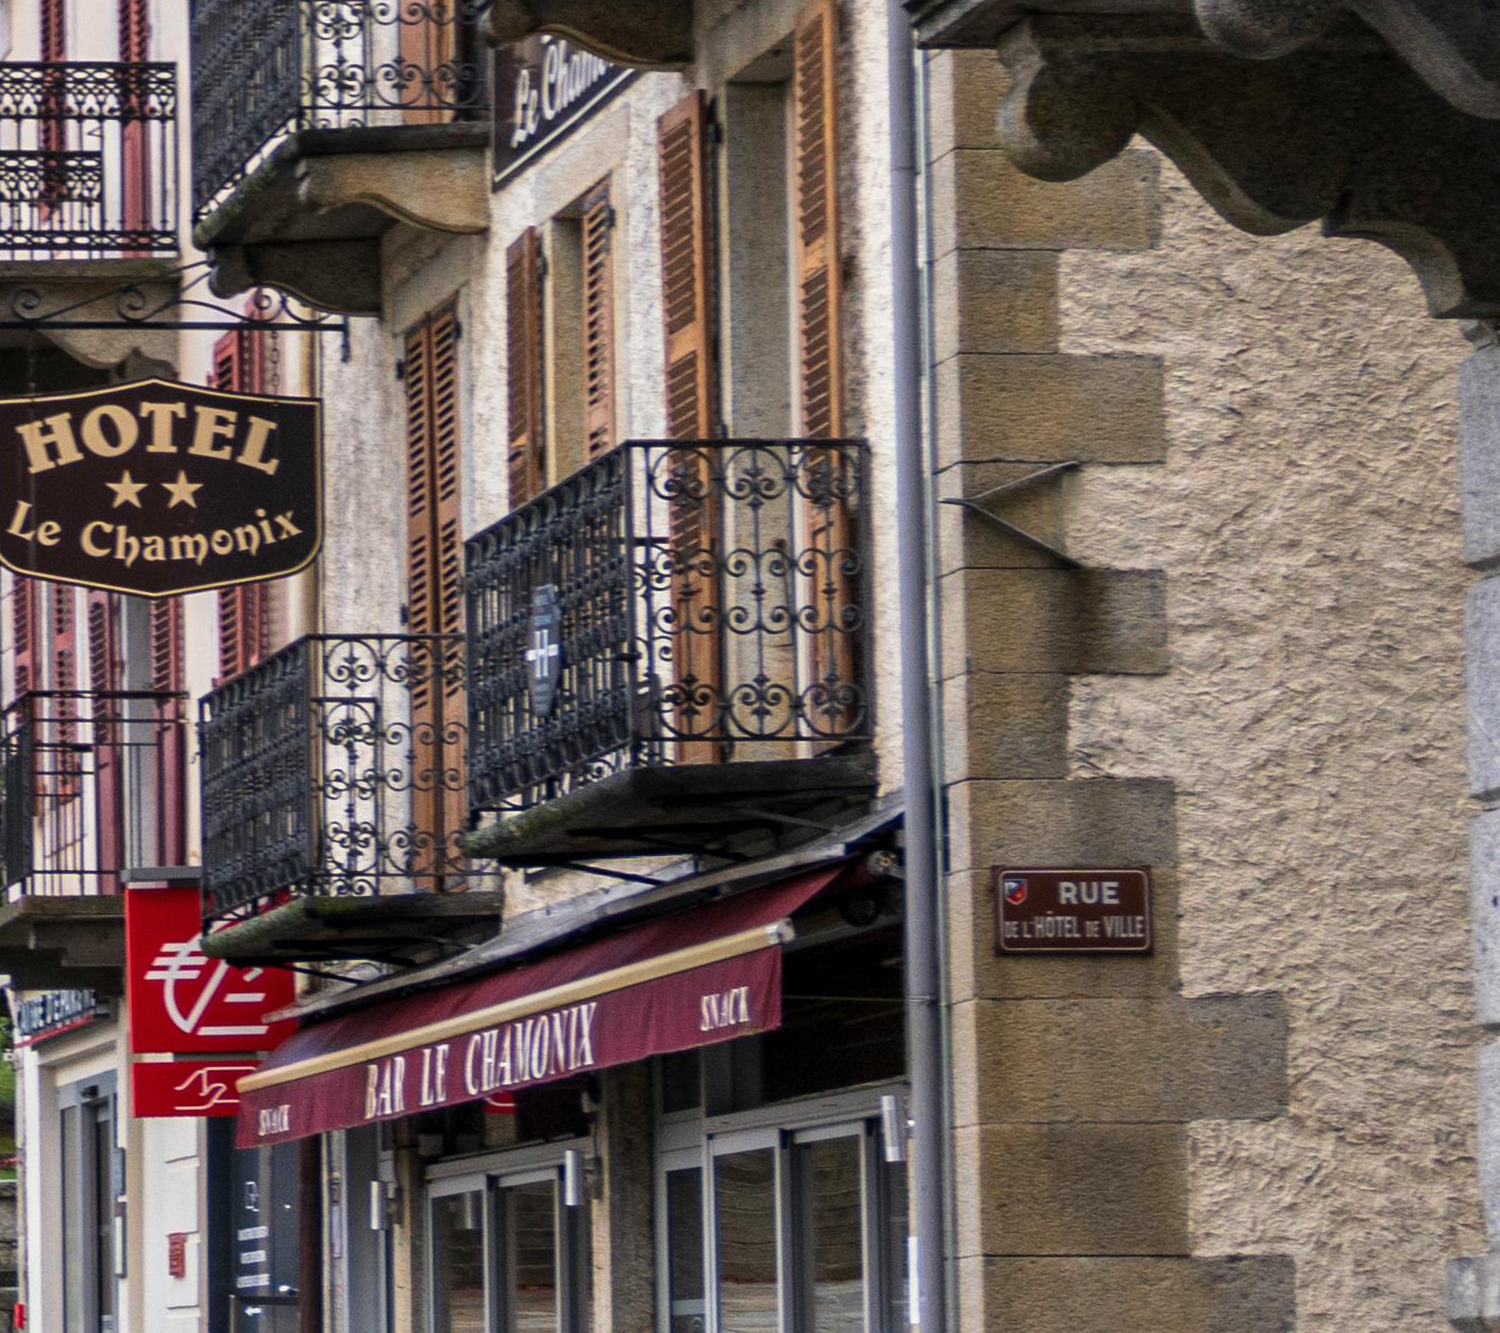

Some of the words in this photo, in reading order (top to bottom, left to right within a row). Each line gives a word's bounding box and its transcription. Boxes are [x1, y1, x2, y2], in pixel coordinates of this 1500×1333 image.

[510, 68, 539, 148] Le
[541, 34, 615, 121] Cham
[14, 400, 281, 476] HOTEL
[5, 500, 62, 547] Le
[80, 508, 304, 568] Chamonix
[1004, 920, 1020, 939] DE
[1084, 920, 1101, 939] DE
[1102, 915, 1145, 939] VILLE
[1058, 881, 1121, 905] RUE
[700, 985, 750, 1032] SNACK
[364, 1055, 406, 1120] BAR
[419, 1043, 450, 1107] LE
[464, 1001, 596, 1096] CHAMONIX
